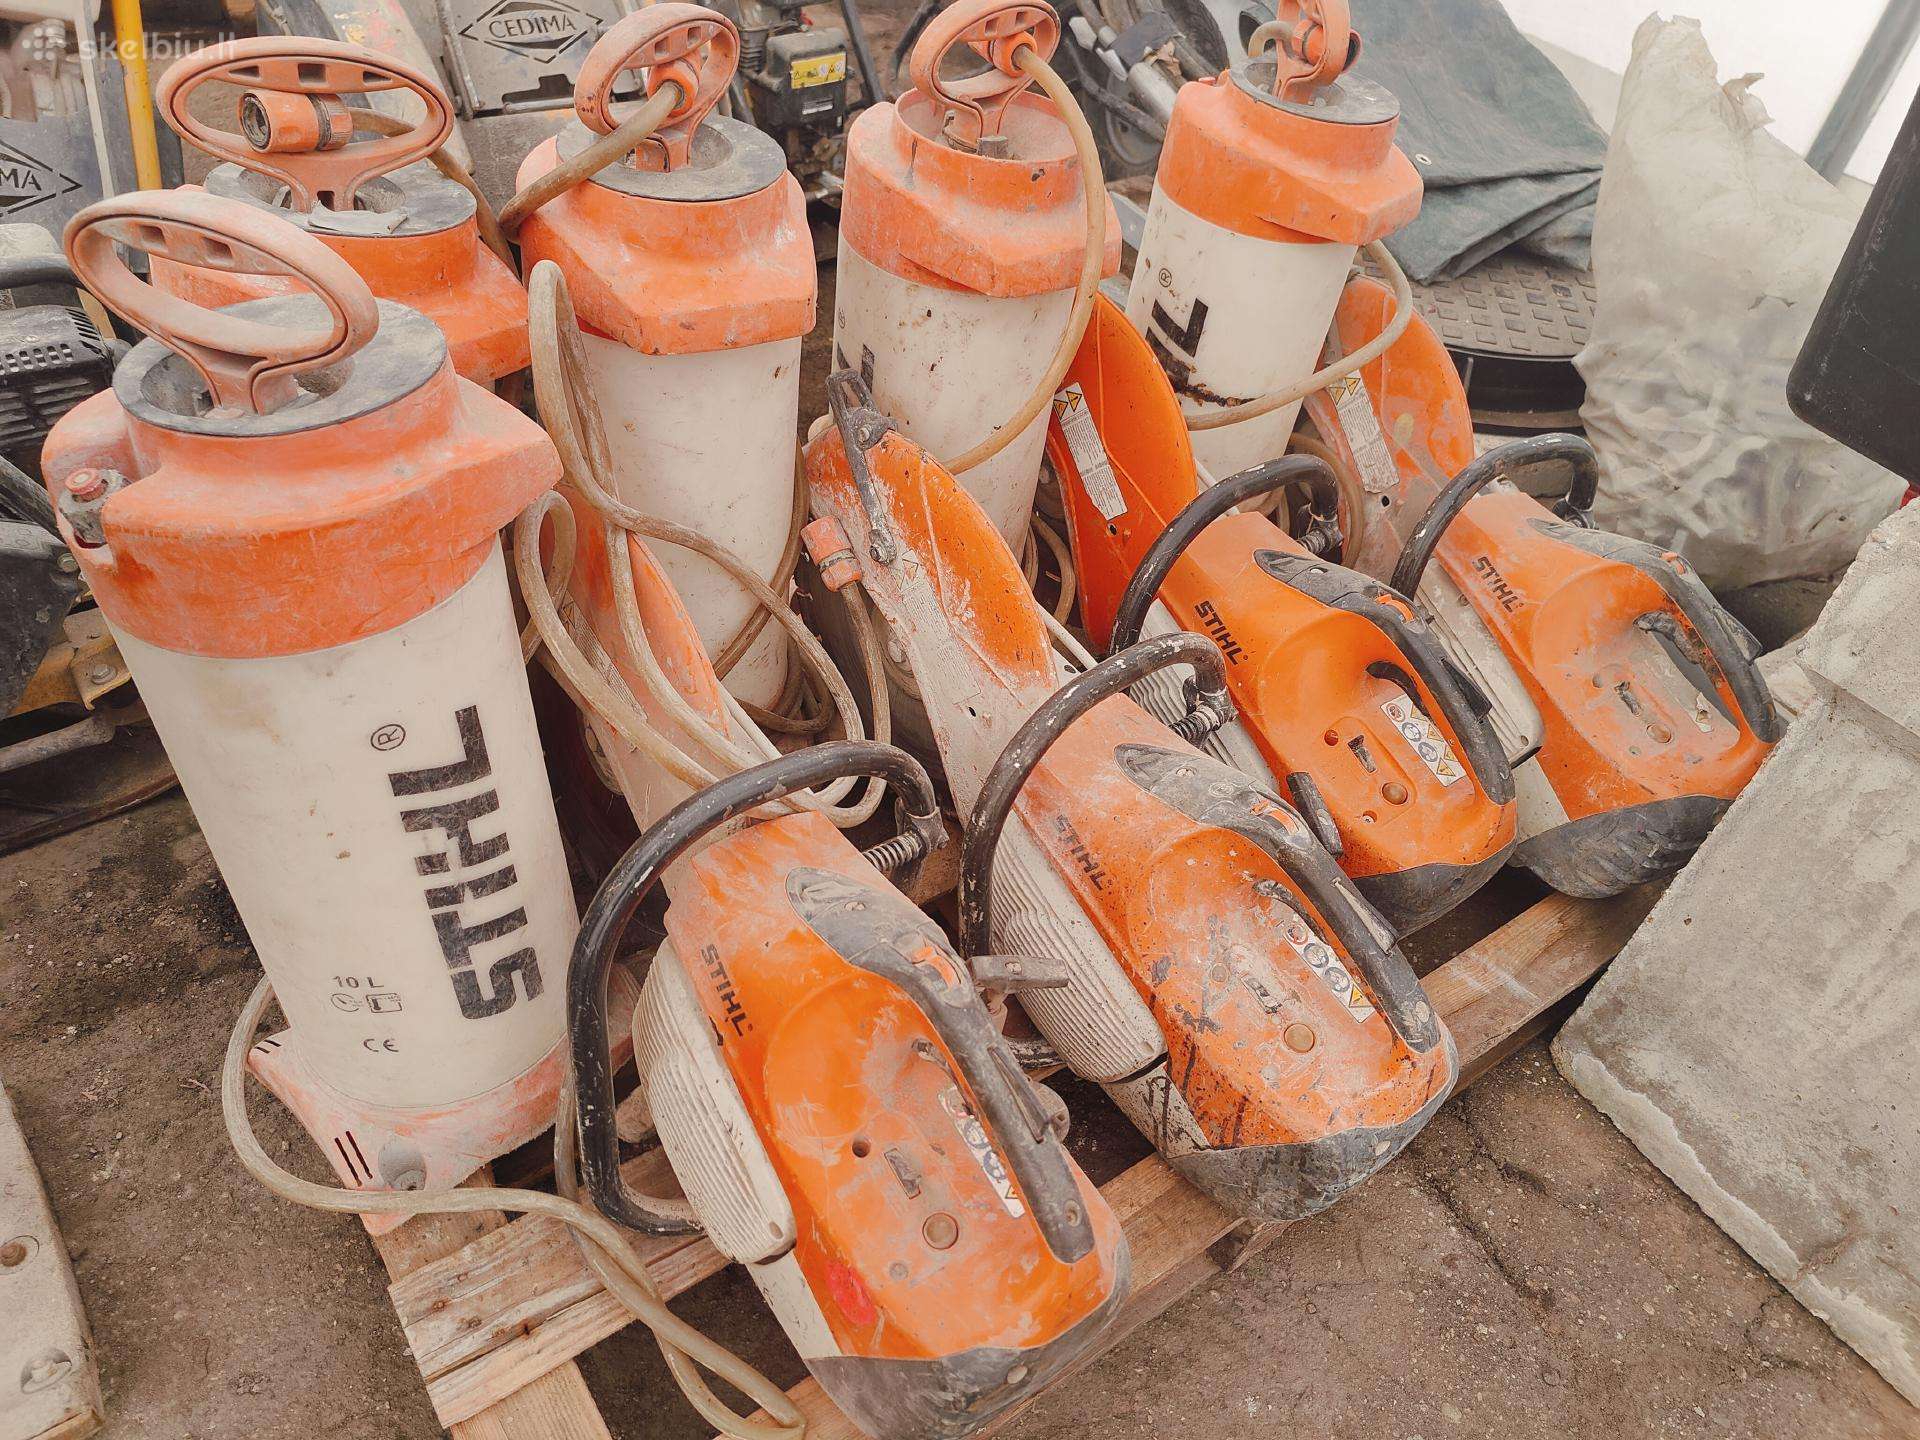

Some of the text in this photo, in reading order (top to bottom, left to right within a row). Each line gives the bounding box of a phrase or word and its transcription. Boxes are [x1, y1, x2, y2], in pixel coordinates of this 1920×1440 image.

[488, 13, 577, 39] CEDIMA
[1471, 556, 1519, 613] STIHL
[1194, 600, 1243, 666] STIHL
[387, 704, 544, 1020] STIHL
[1055, 814, 1106, 891] STIHL
[332, 975, 360, 989] 10
[700, 943, 747, 1037] STIHL
